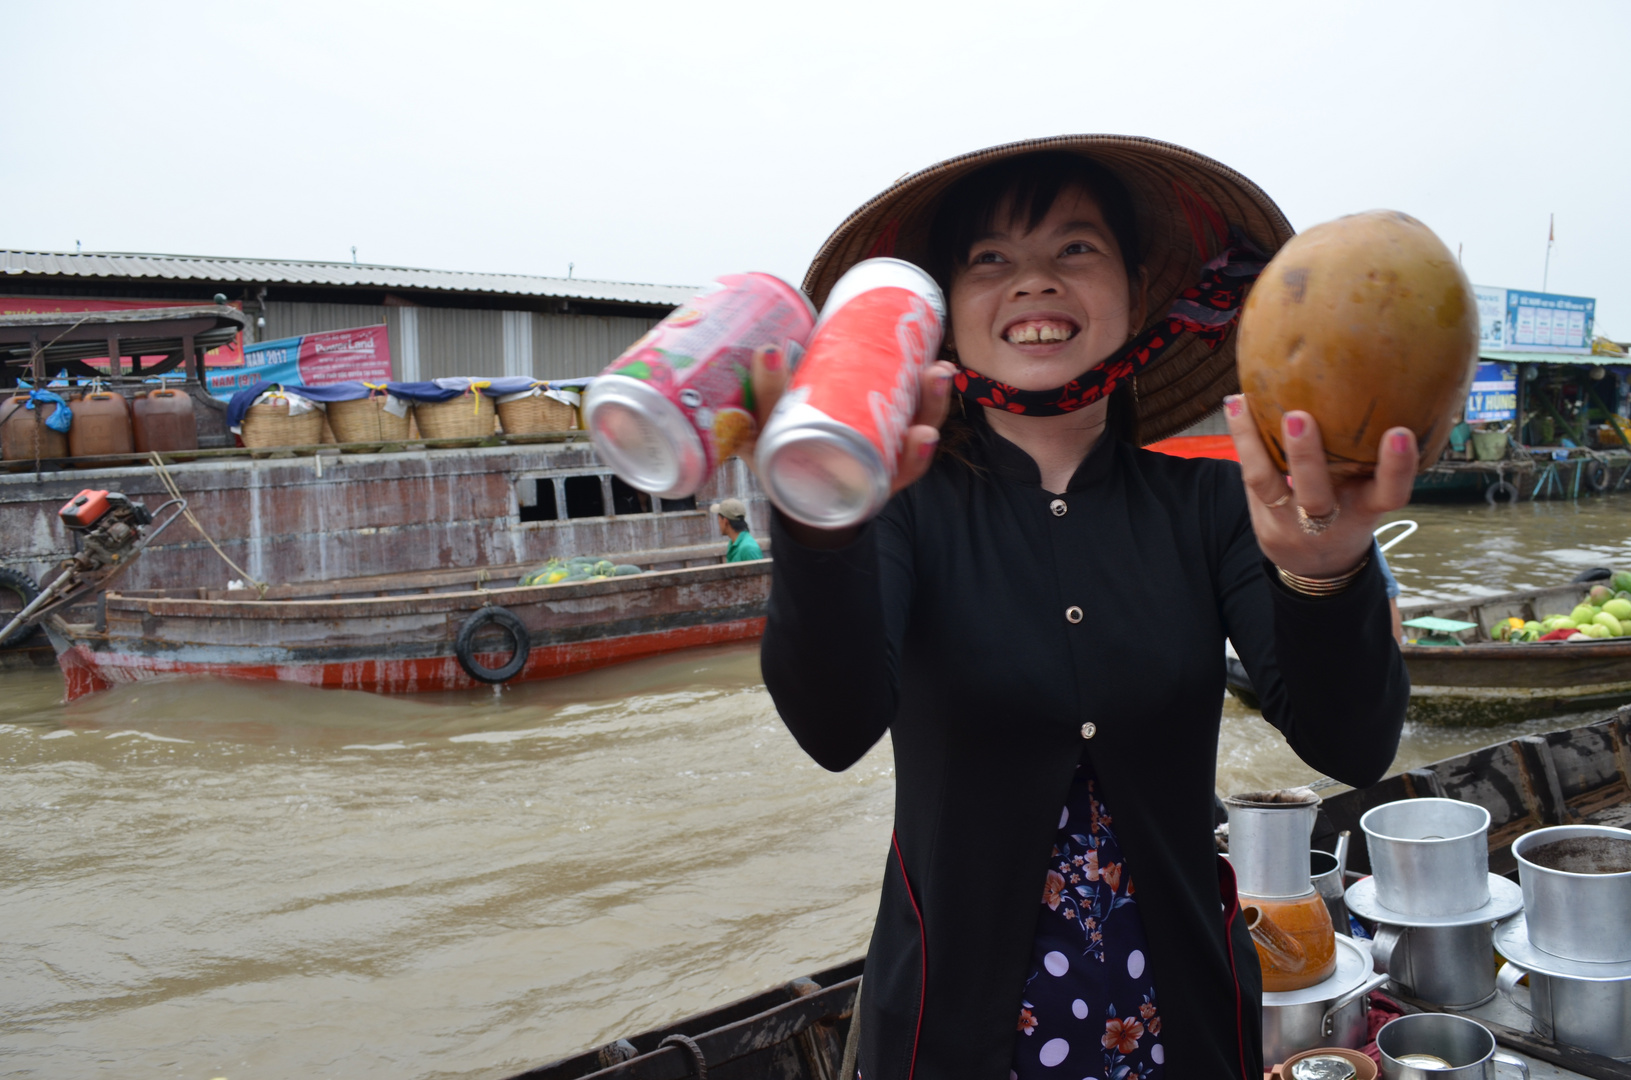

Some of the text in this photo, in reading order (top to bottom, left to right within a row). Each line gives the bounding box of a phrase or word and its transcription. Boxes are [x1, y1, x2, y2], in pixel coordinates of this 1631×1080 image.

[245, 350, 266, 368] NAM
[266, 348, 287, 366] 2017
[211, 375, 235, 388] NAM
